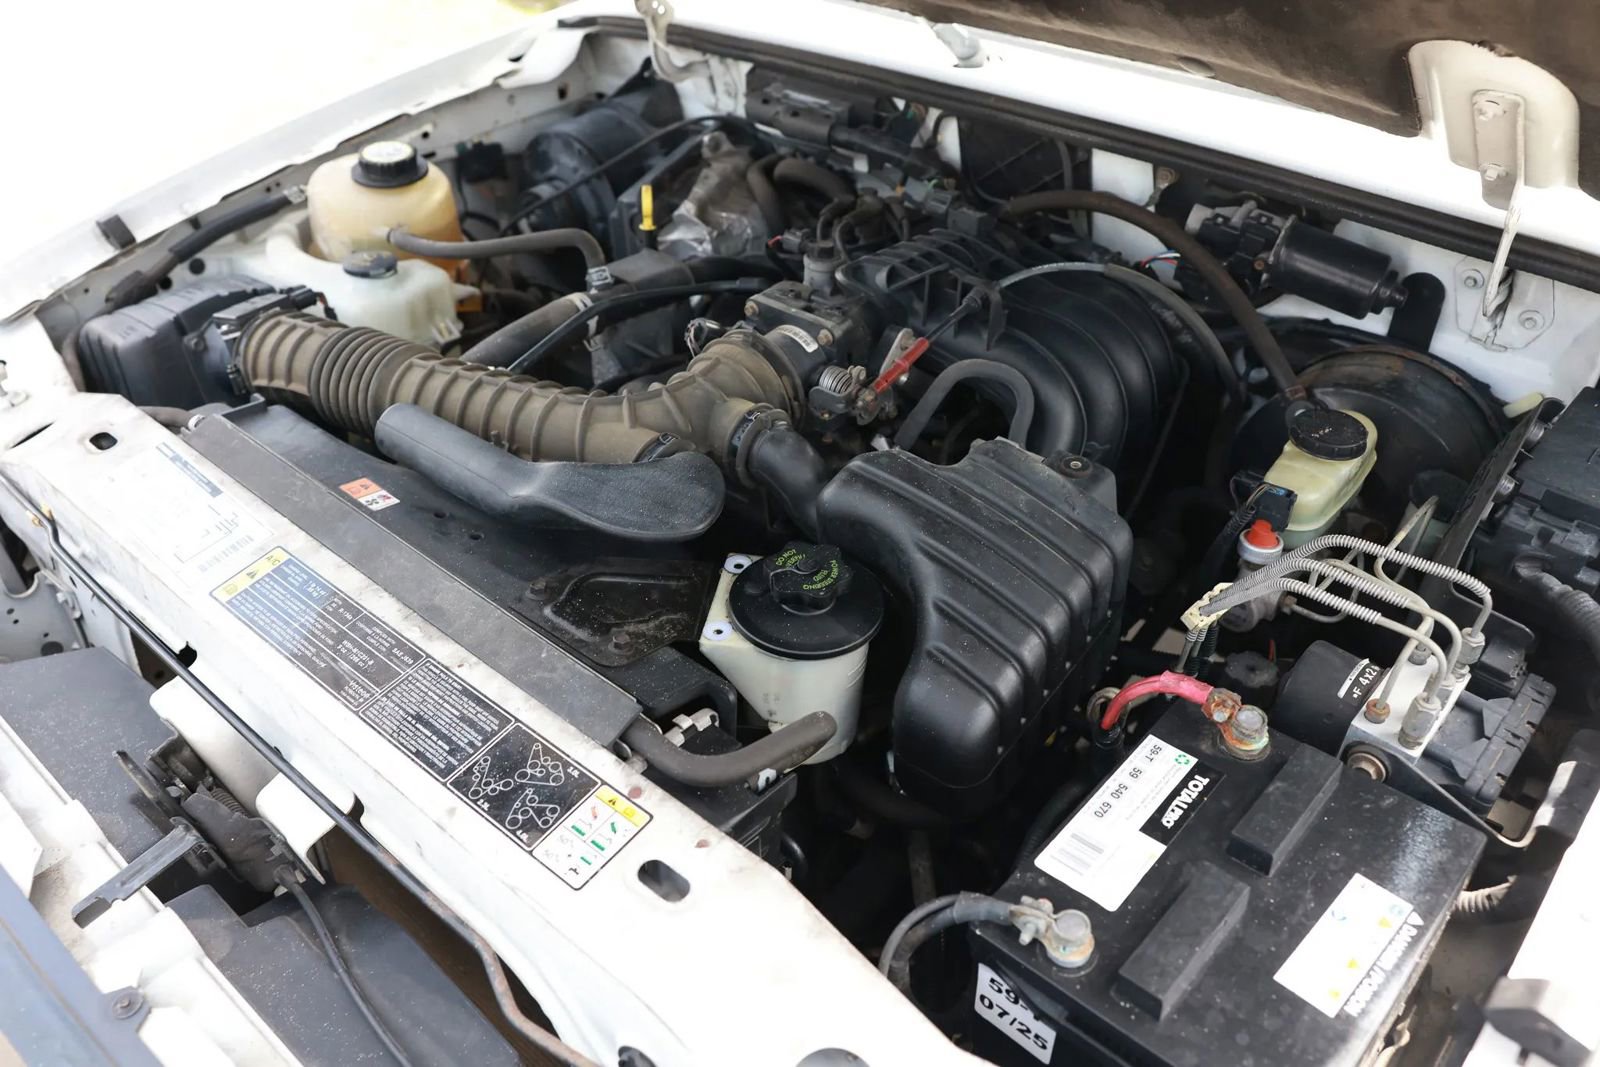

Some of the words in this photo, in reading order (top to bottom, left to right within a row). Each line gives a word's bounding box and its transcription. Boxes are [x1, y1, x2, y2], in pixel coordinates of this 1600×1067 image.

[1145, 744, 1162, 762] 59-T
[1129, 767, 1142, 779] 59
[1110, 783, 1128, 799] 540
[1094, 801, 1112, 818] 670
[989, 977, 1041, 1022] 59-
[979, 993, 1049, 1050] 07/25
